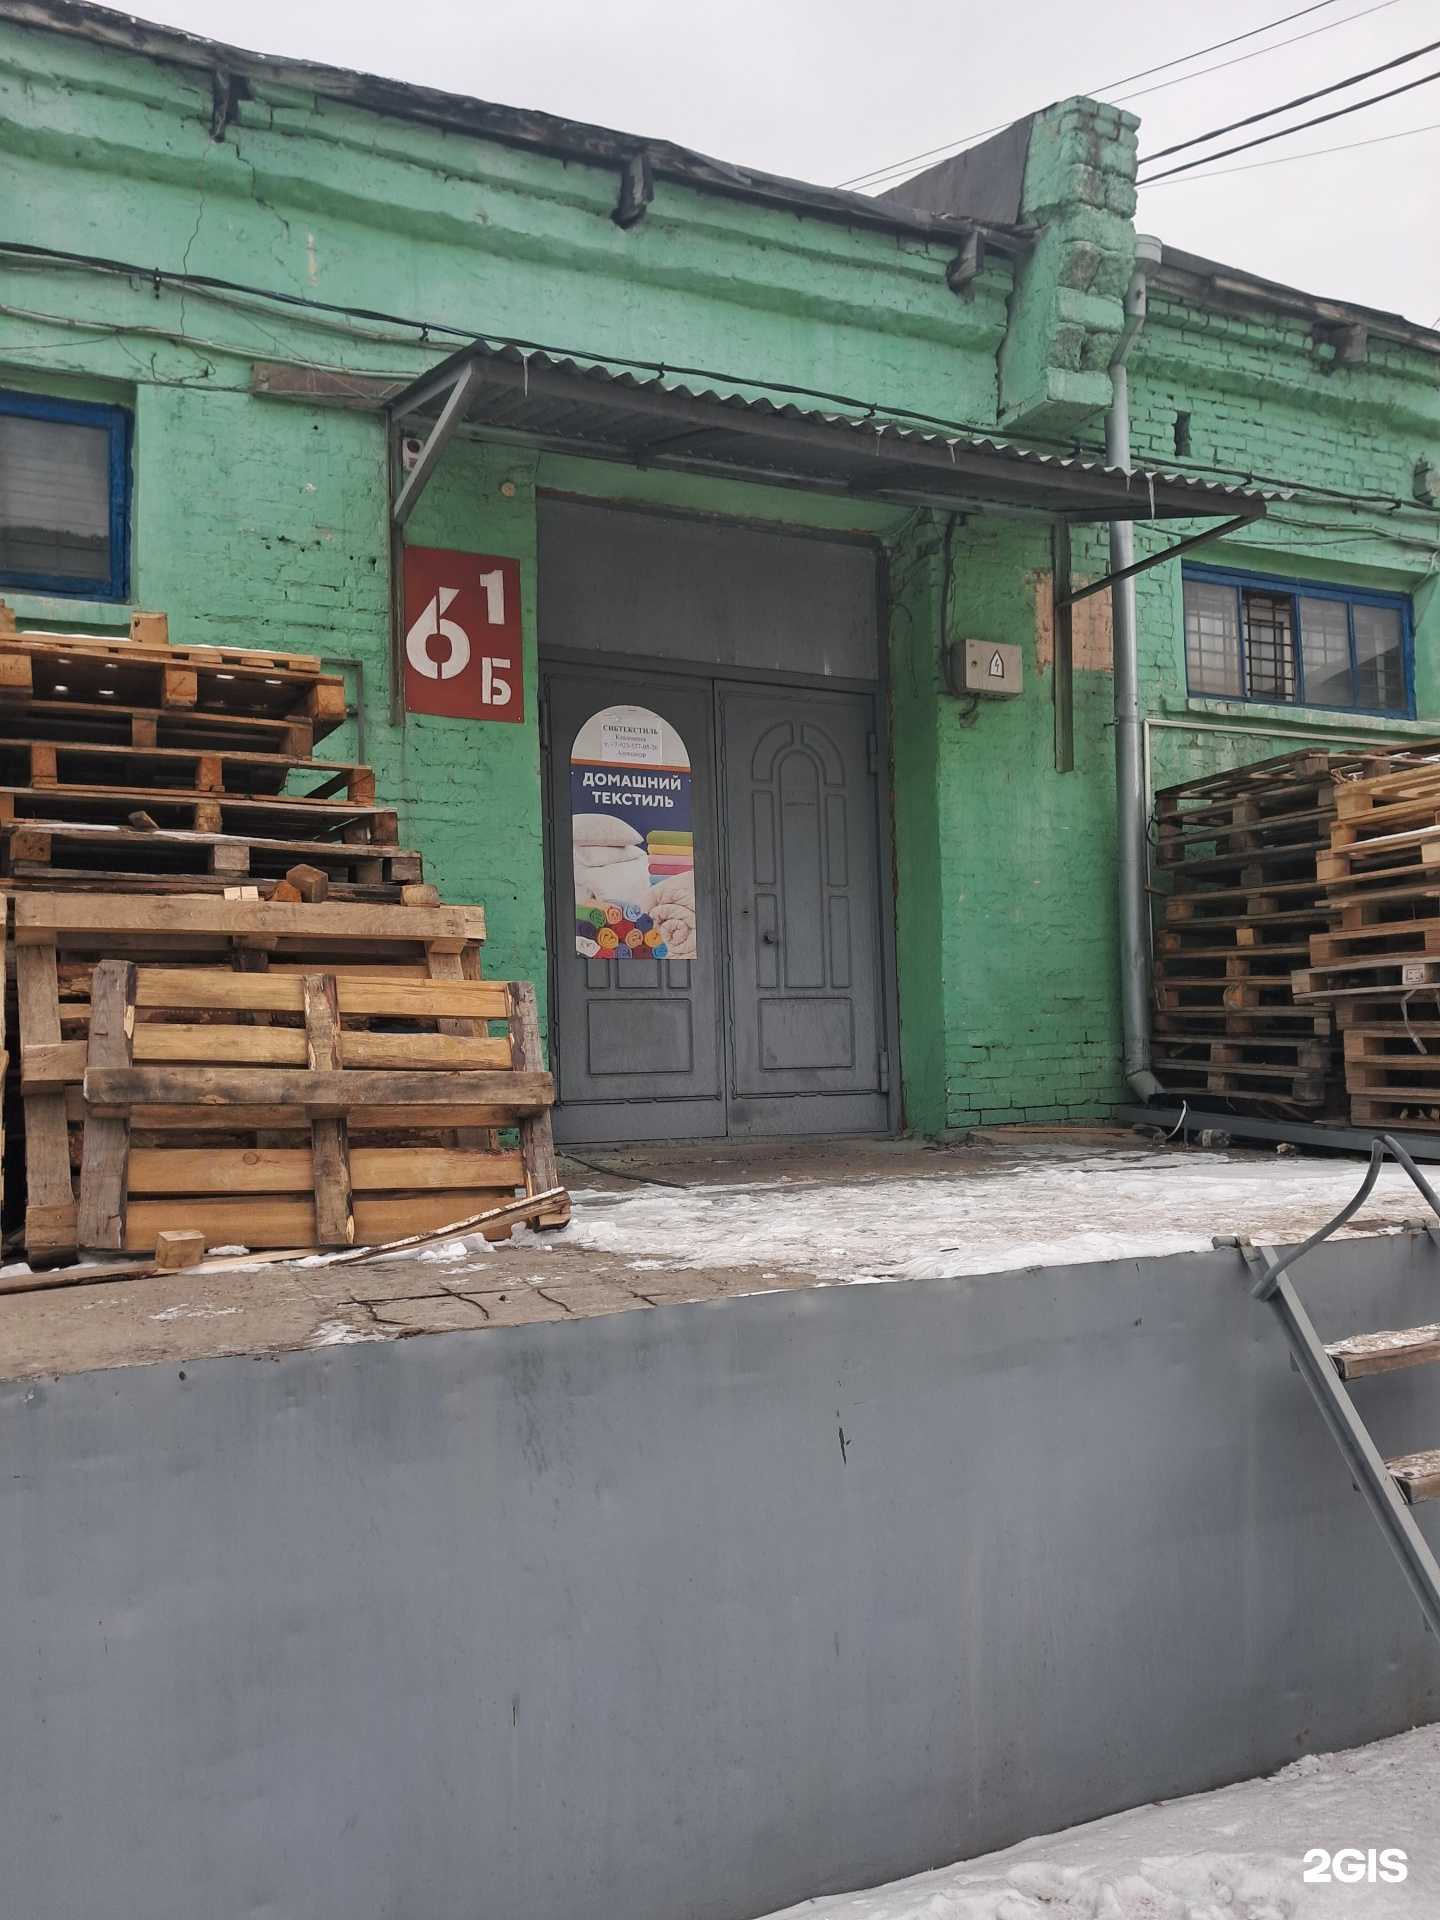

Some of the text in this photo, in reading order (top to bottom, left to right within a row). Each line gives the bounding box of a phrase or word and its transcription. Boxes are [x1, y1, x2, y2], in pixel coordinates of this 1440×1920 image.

[480, 570, 505, 625] 1
[406, 587, 471, 680] 6
[482, 657, 512, 705] Б
[582, 772, 681, 791] ДОМАШНИЙ
[592, 791, 675, 808] ТЕКСТИЛЬ
